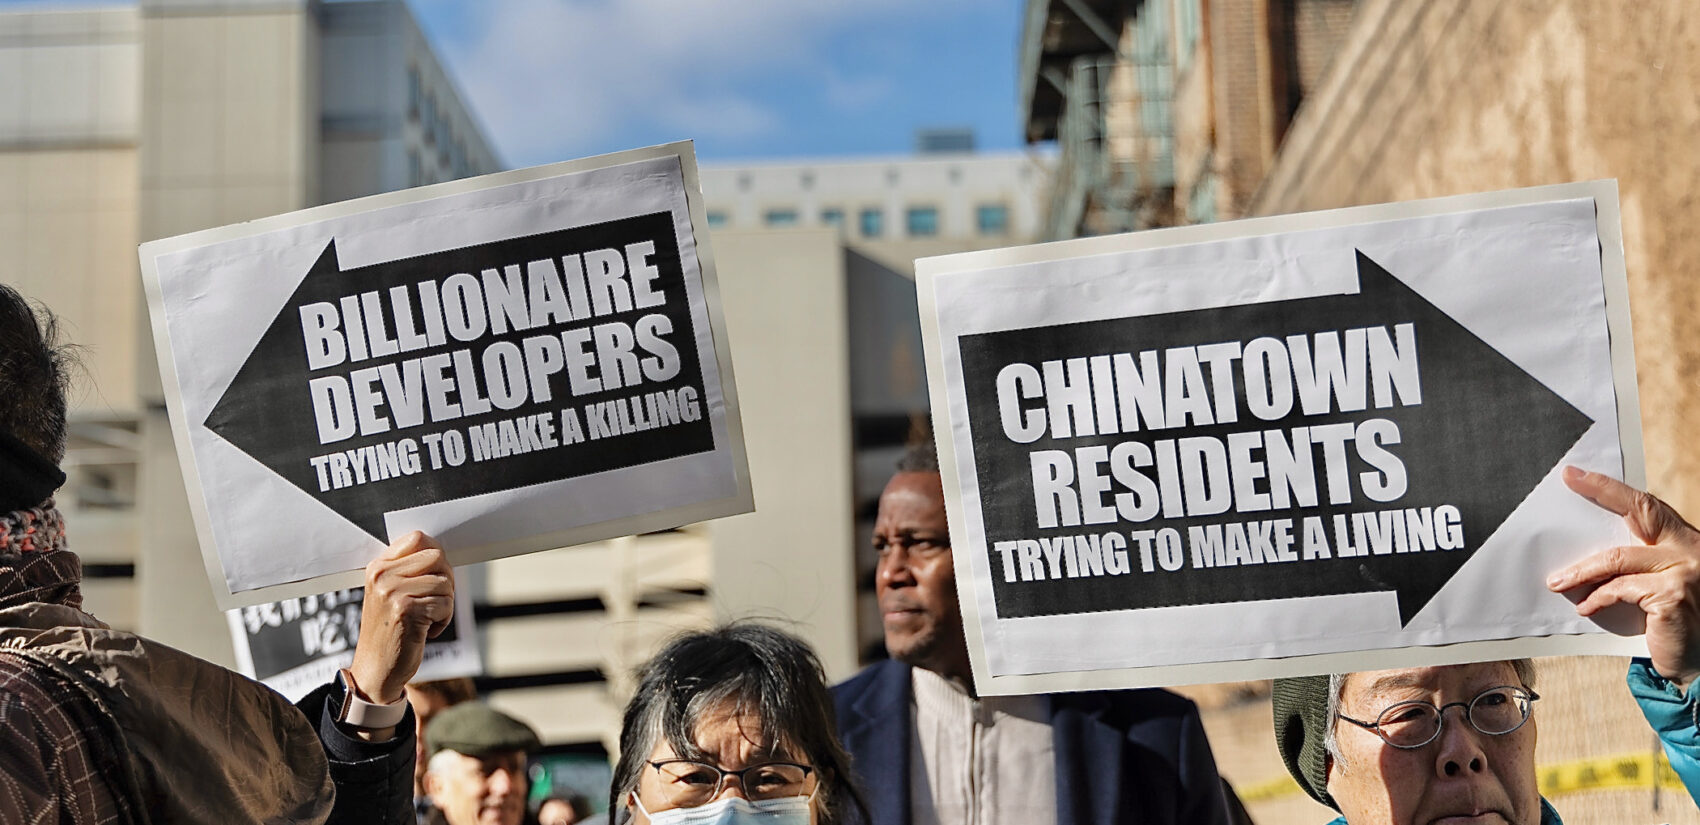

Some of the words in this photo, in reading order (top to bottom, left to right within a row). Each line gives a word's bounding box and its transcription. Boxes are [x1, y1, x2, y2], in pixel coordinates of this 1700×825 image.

[299, 240, 666, 371] BILLIONAIRE
[309, 314, 681, 445] DEVELOPERS
[996, 322, 1422, 444] CHINATOWN
[310, 438, 422, 493] TRYING
[422, 429, 466, 470] TO
[469, 412, 559, 463] MAKE
[561, 407, 586, 446] A
[584, 386, 702, 441] KILLING
[1029, 418, 1407, 530] RESIDENTS
[994, 531, 1131, 583] TRYING
[1132, 527, 1184, 573] TO
[1188, 519, 1298, 569] MAKE
[1302, 515, 1332, 560] A
[1332, 505, 1465, 558] LIVING
